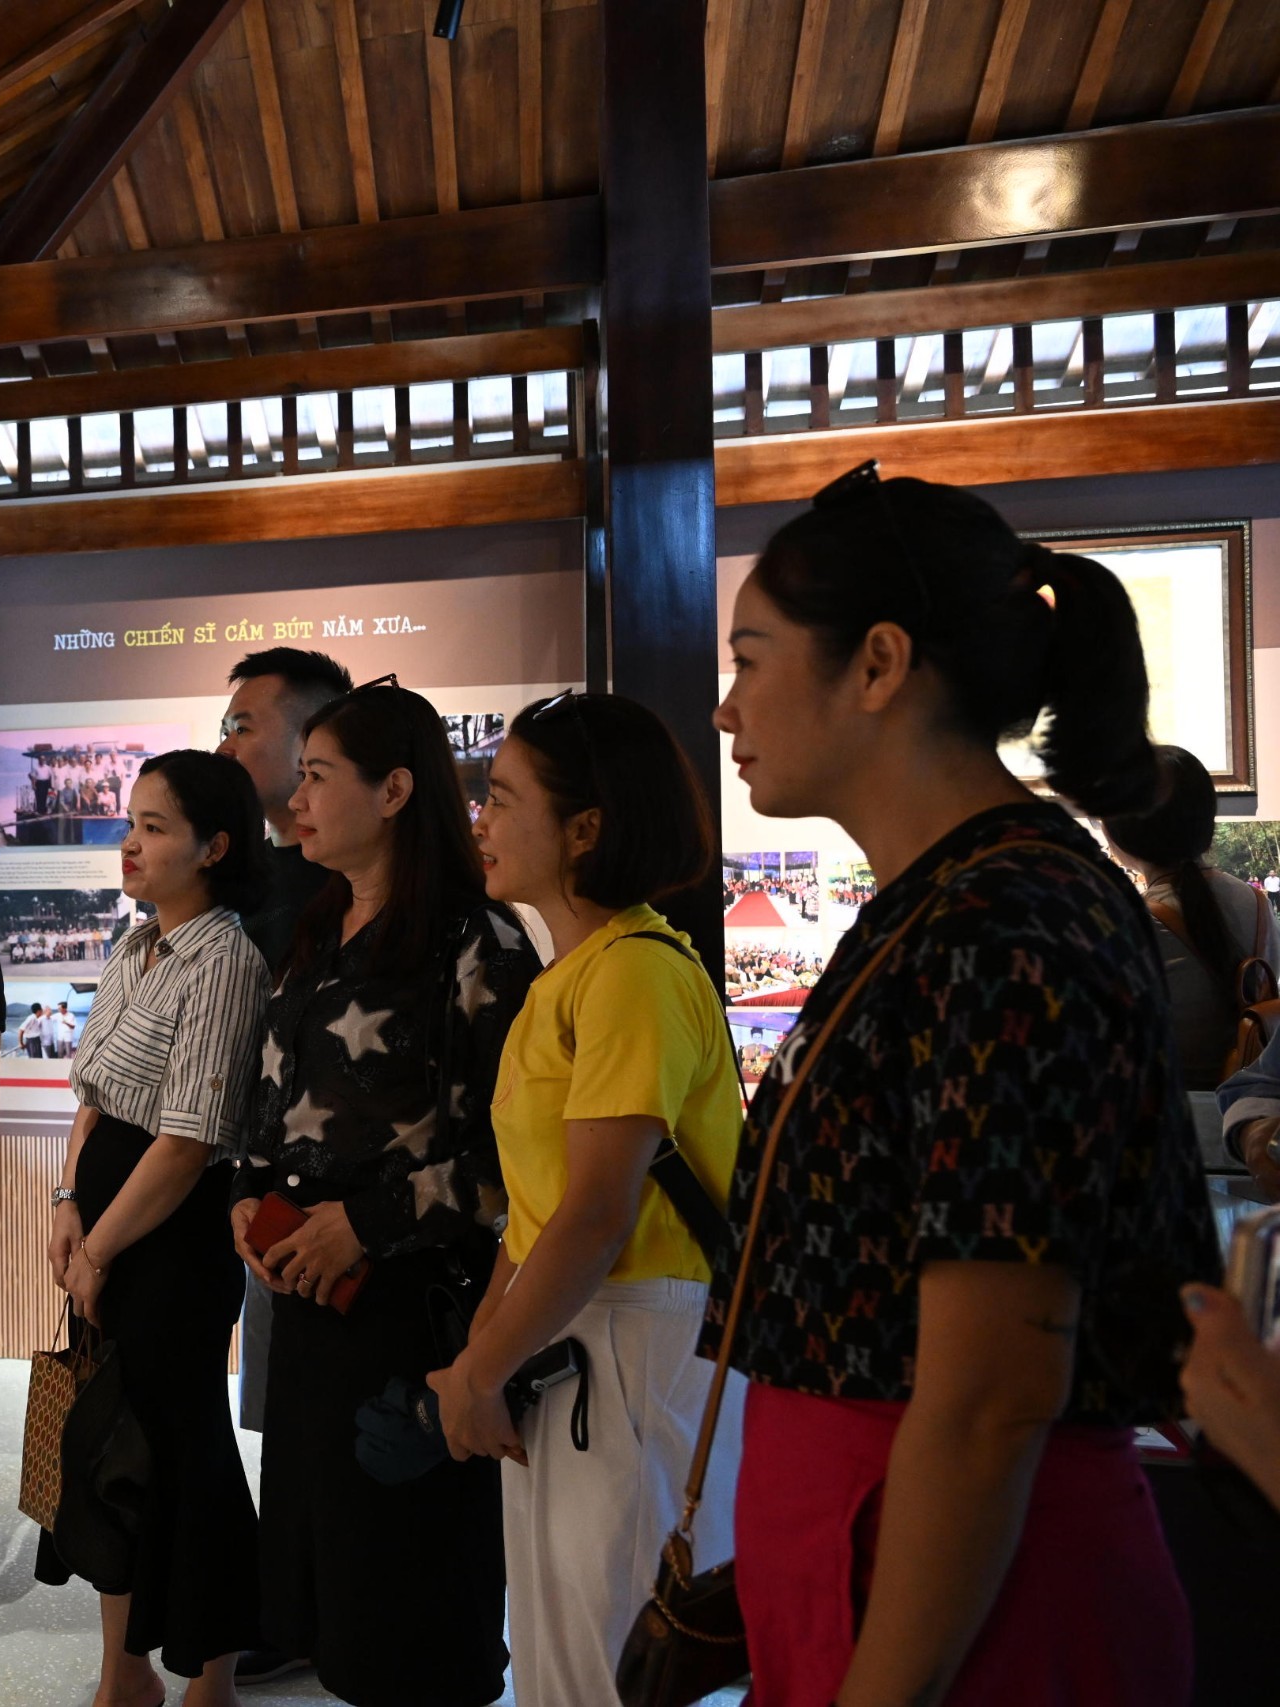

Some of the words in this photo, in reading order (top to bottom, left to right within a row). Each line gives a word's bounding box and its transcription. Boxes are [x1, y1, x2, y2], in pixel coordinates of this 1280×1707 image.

[53, 629, 115, 651] NHỮNG
[124, 622, 185, 648] CHIẾN
[193, 621, 218, 644] SĨ
[224, 618, 265, 642] CẦM
[273, 616, 313, 640] BÚT
[321, 615, 364, 638] NĂM
